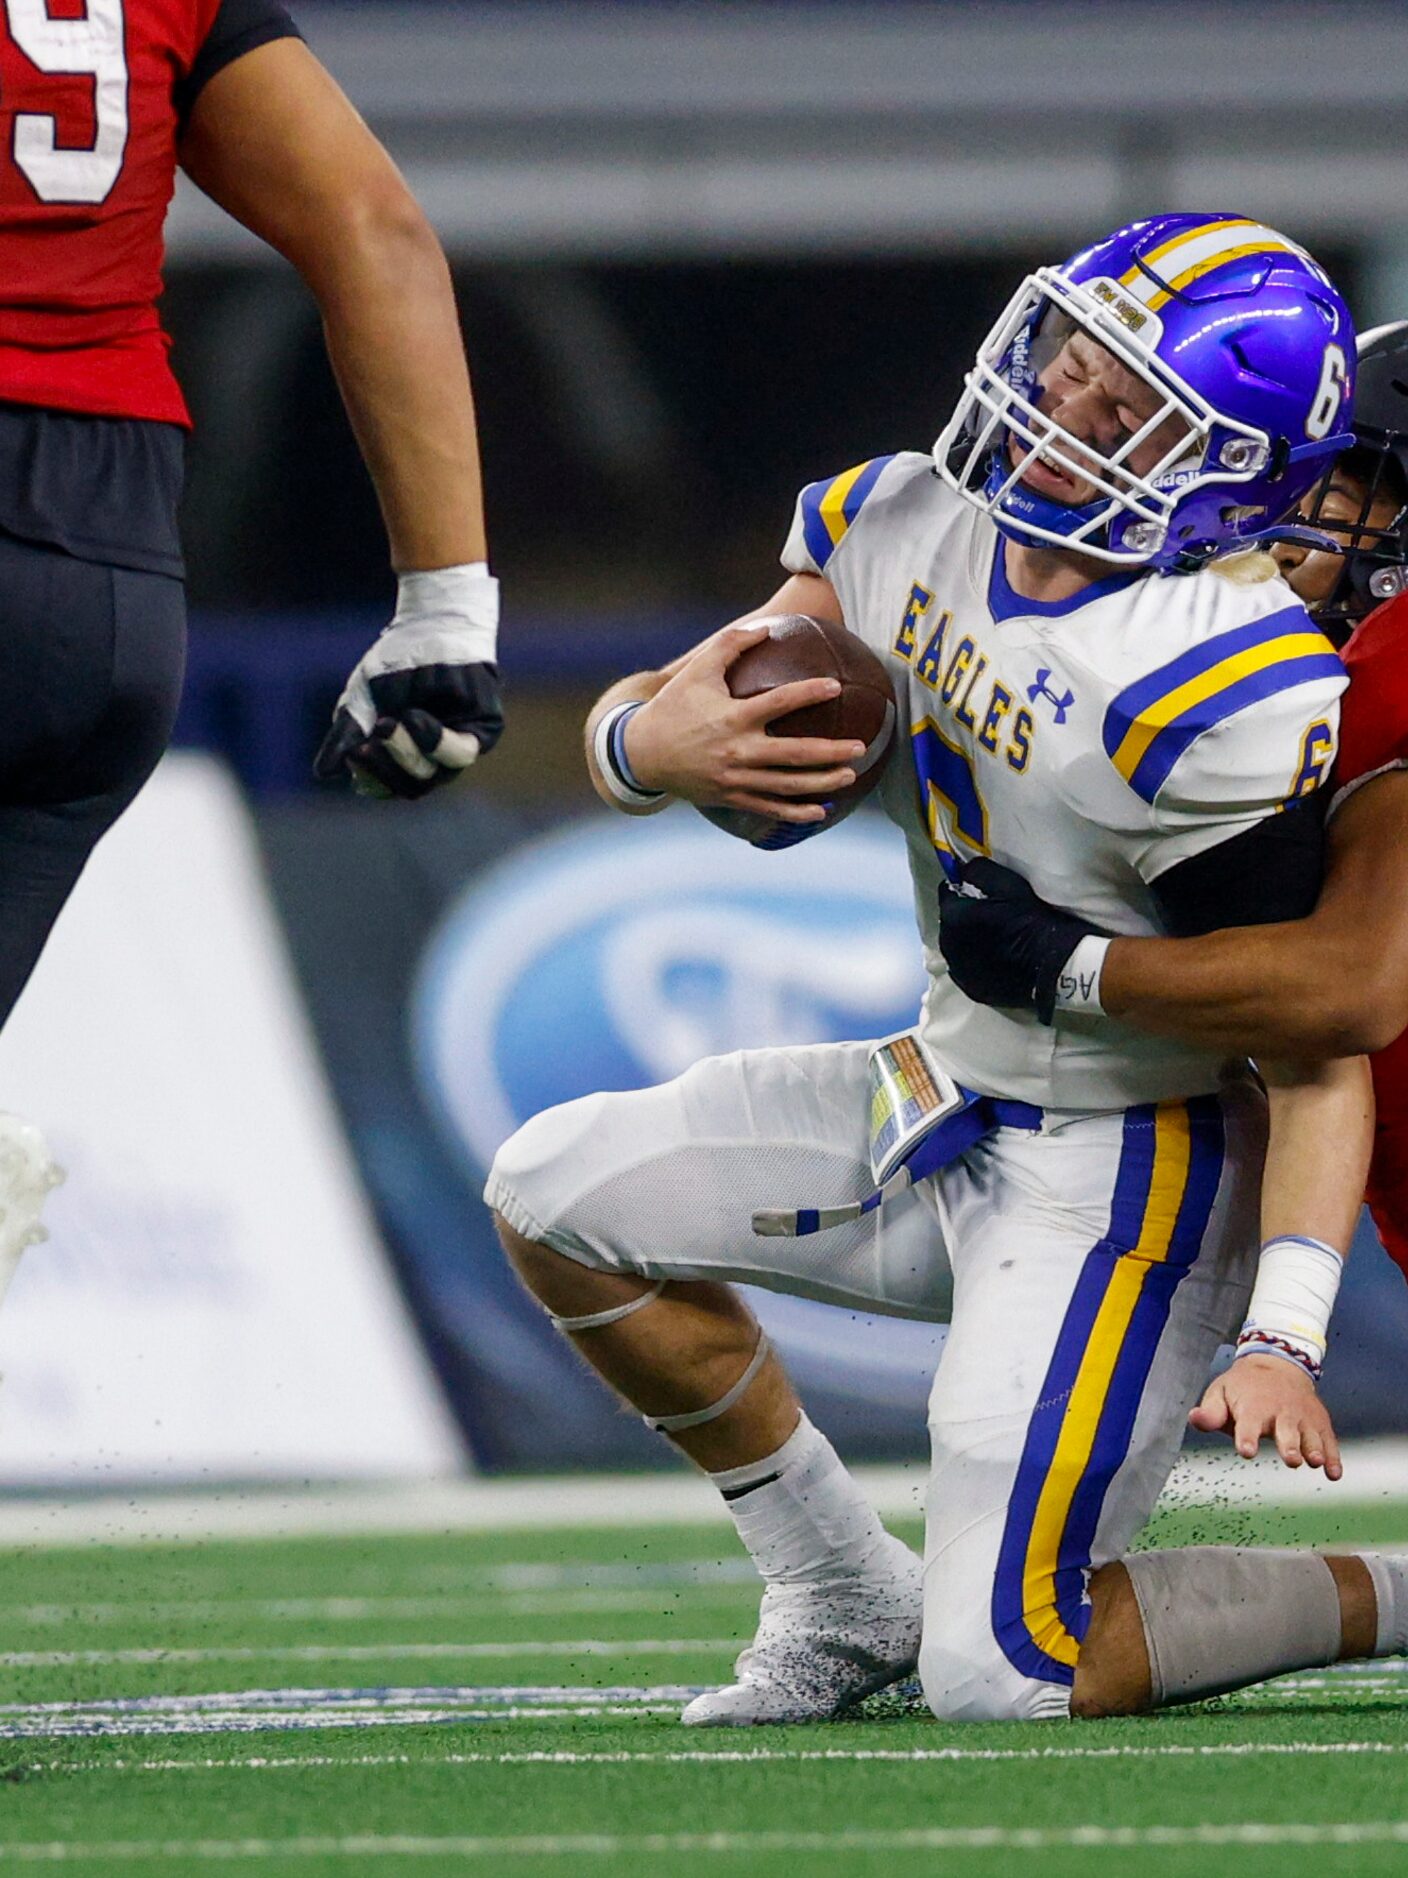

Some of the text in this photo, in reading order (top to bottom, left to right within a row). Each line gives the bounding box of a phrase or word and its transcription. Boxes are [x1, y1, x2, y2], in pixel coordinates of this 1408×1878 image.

[7, 0, 128, 204] 9
[1304, 342, 1346, 441] 6
[891, 579, 1036, 776] EAGLES
[1275, 717, 1334, 813] 6
[1057, 970, 1097, 1001] AG
